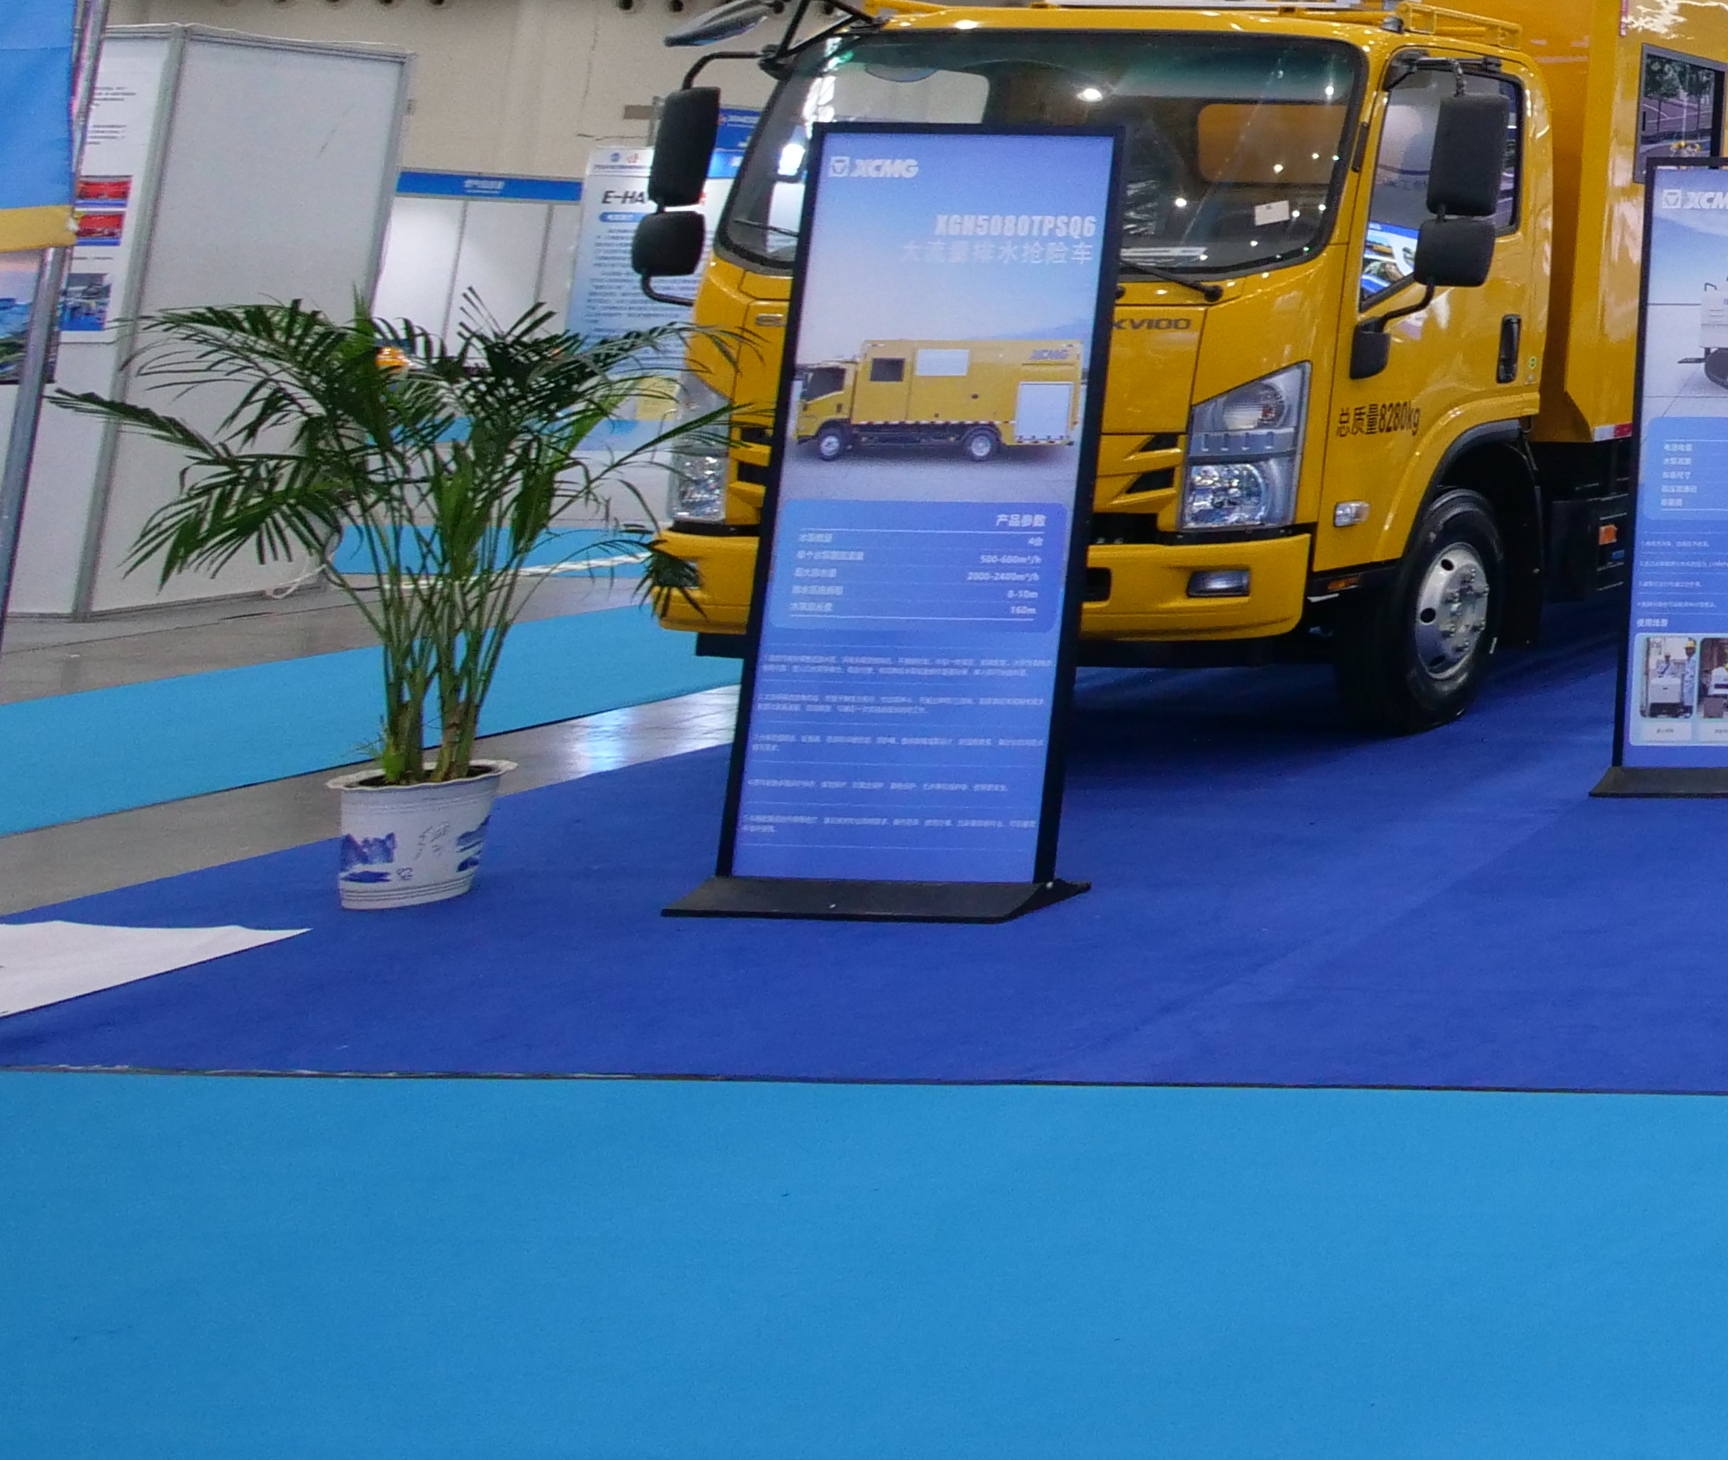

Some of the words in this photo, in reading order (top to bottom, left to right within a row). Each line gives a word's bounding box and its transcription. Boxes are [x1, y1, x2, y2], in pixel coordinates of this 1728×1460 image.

[850, 159, 919, 178] XCMG
[996, 514, 1047, 527] 产品参数
